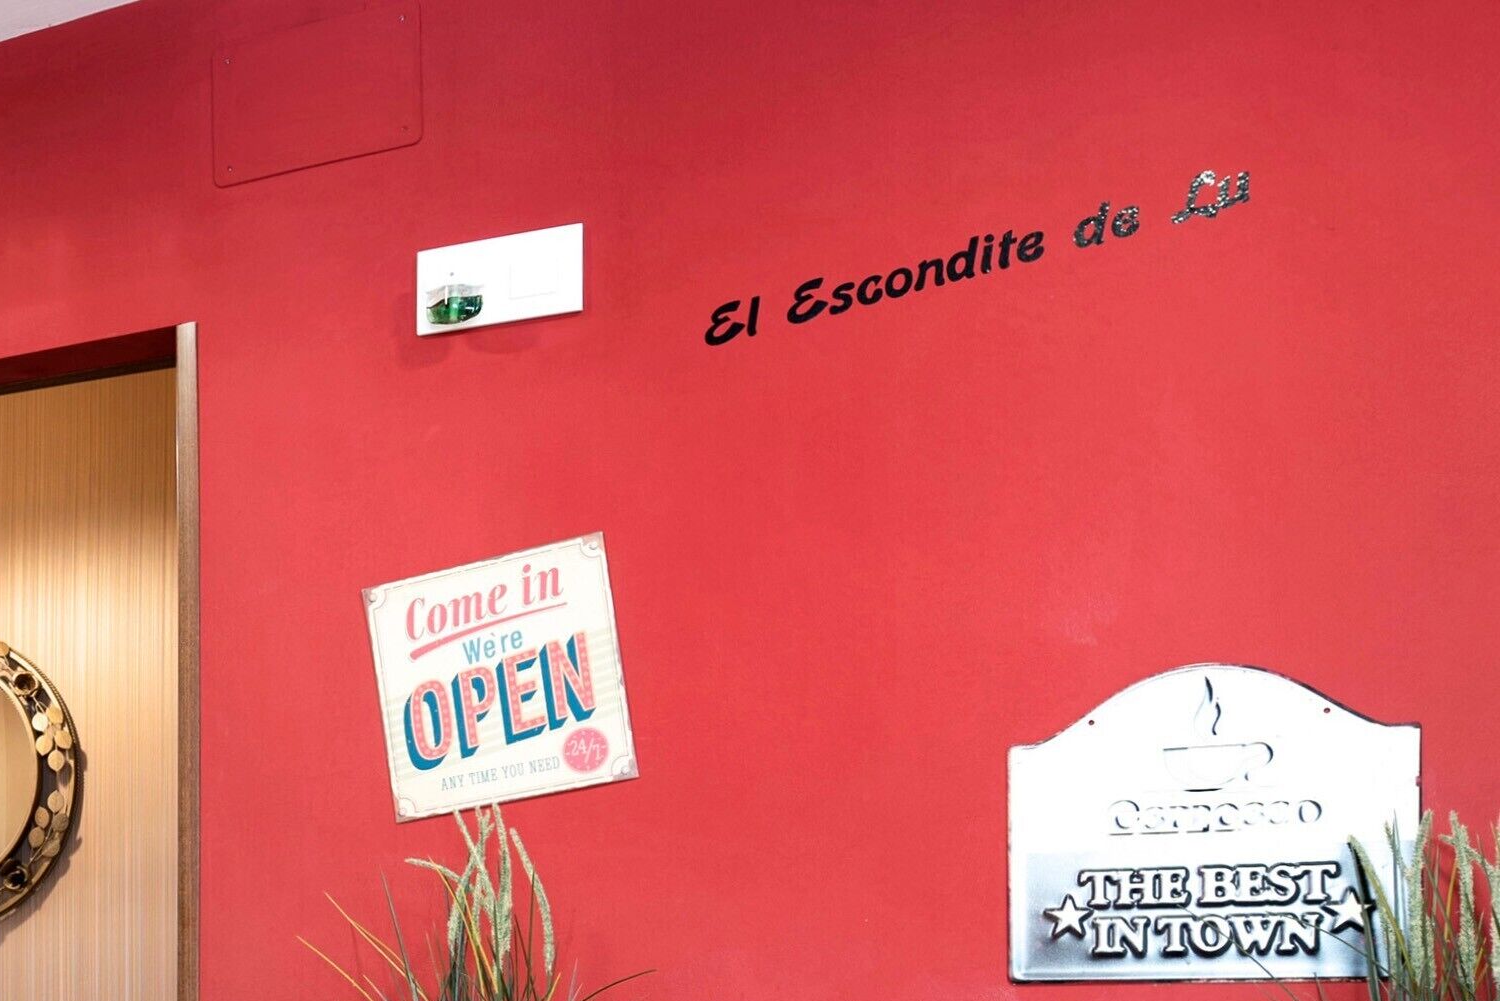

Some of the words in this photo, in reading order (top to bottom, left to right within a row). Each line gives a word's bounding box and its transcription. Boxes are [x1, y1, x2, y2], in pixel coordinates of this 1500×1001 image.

[703, 295, 761, 346] El
[786, 229, 1045, 325] Escondite
[1072, 201, 1141, 249] de
[1170, 169, 1251, 225] Lu
[405, 583, 508, 641] Come
[520, 563, 565, 606] in
[462, 630, 524, 665] We're
[403, 631, 598, 771] OPEN
[441, 772, 465, 792] ANY
[468, 767, 498, 785] TIME
[501, 762, 525, 779] YOU
[528, 755, 561, 774] NEED
[570, 740, 601, 763] 24/7
[1078, 866, 1190, 909] THE
[1197, 861, 1341, 907] BEST
[1090, 913, 1151, 959] IN
[1156, 911, 1325, 959] TOWN
